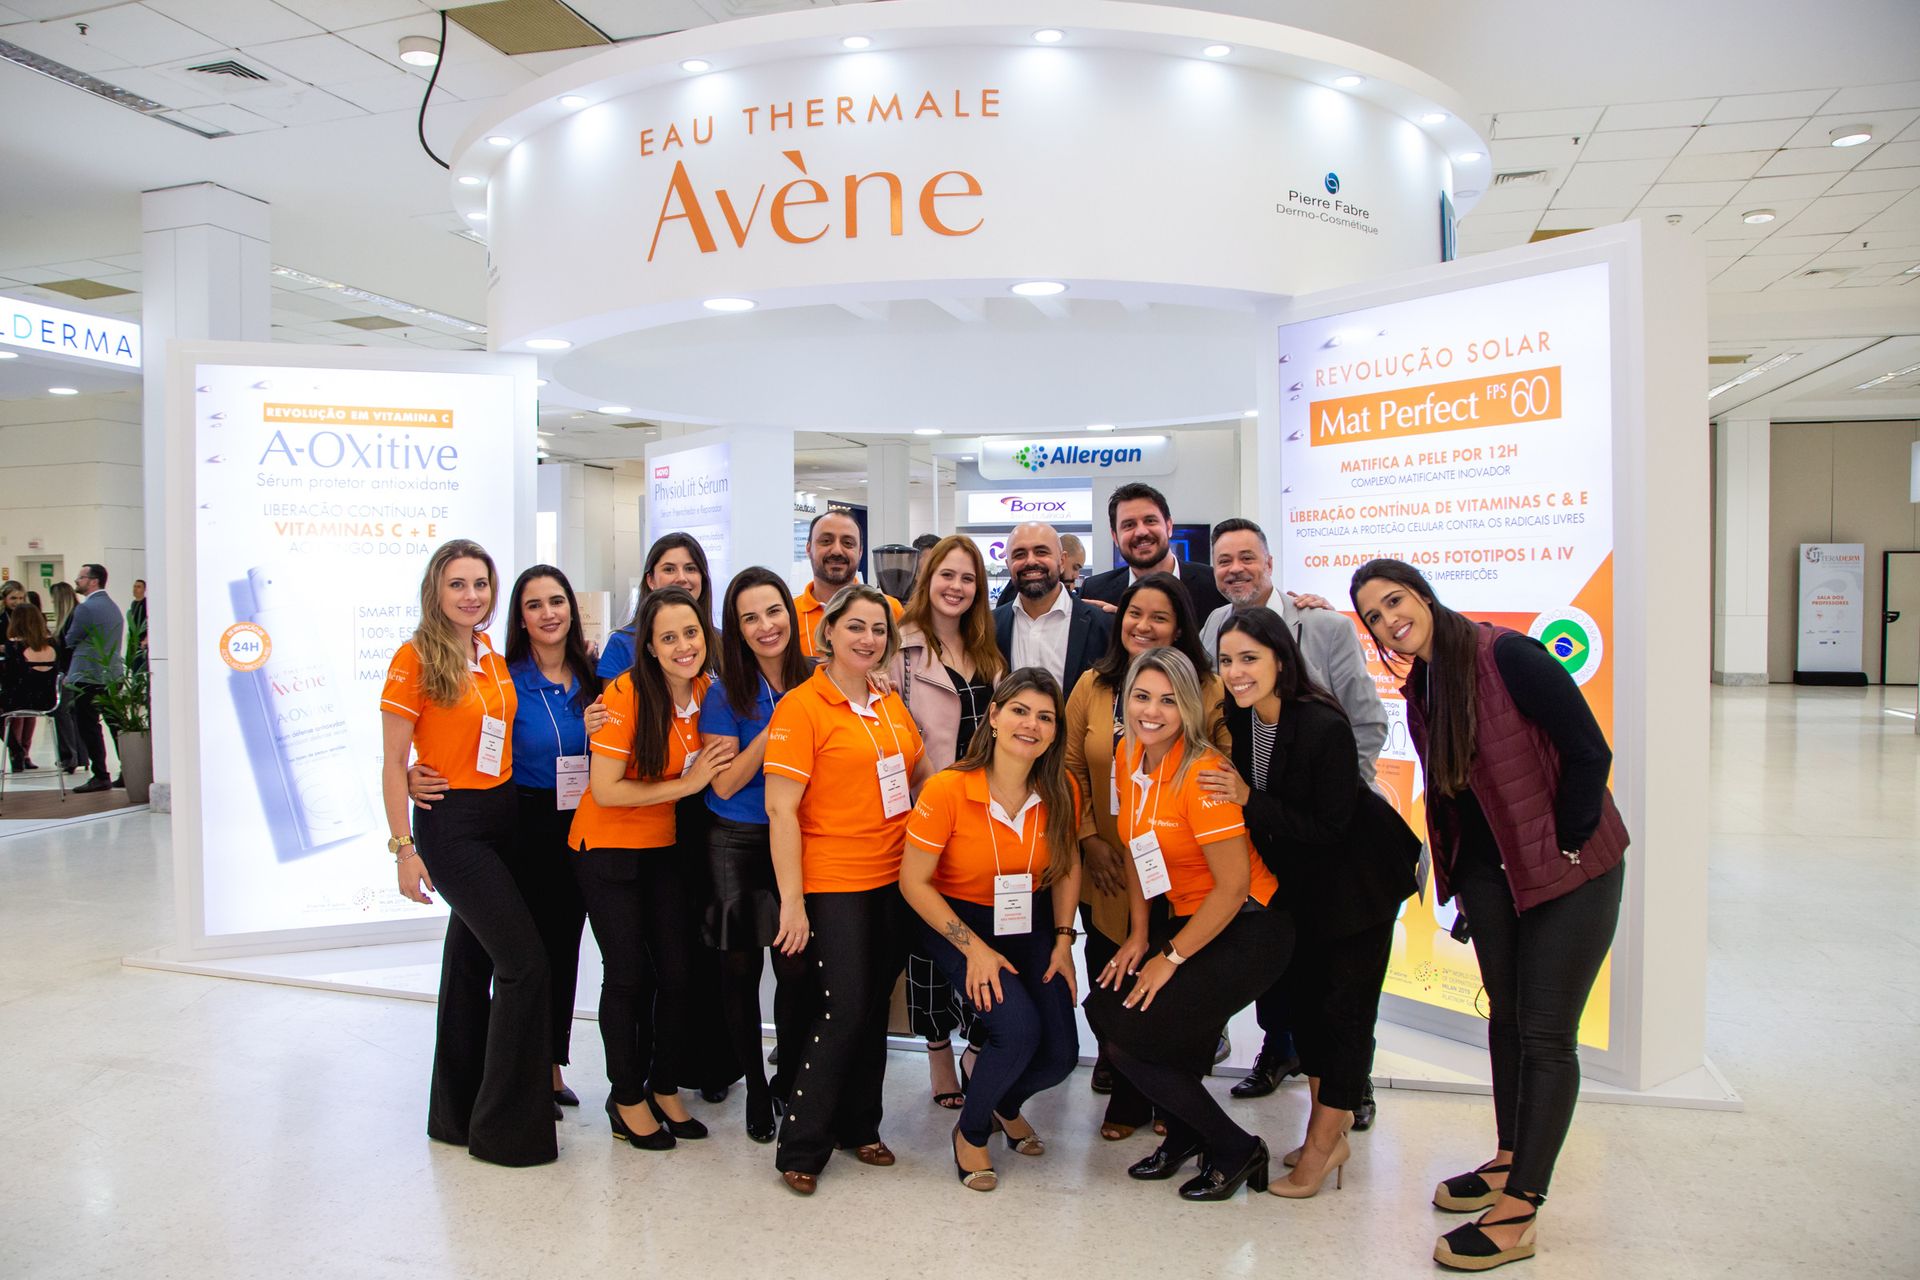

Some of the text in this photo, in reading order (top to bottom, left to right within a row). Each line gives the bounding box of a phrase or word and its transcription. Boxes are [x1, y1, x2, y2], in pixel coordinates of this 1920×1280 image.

[640, 89, 1000, 157] EAU THERMALE
[647, 149, 984, 262] Avène
[1288, 190, 1370, 219] Pierre Fabre
[1276, 203, 1379, 235] Dermo-Cosmétique
[0, 313, 132, 358] DERMA
[1315, 331, 1551, 387] REVOLUÇÃO SOLAR
[267, 407, 450, 423] REVOLUÇÃO EM VITAMINA C
[1320, 375, 1550, 437] Mat Perfect FPS 60
[258, 430, 459, 471] A-OXitive
[1051, 446, 1142, 467] Allergan
[1340, 444, 1518, 473] MATIFICA A PELE POR 12H
[257, 472, 460, 492] Sérum protetor antioxidante
[1351, 465, 1511, 488] COMPLEXO MATIFICANTE INOVADOR
[654, 474, 728, 504] PhysioLift Sérum
[263, 502, 449, 519] LIBERAÇÃO CONTÍNUA DE
[1289, 491, 1588, 523] LIBERAÇÃO CONTÍNUA DE VITAMINAS C & E
[274, 522, 386, 537] VITAMINAS
[391, 523, 403, 537] C
[427, 523, 437, 538] E
[1296, 513, 1585, 538] POTENCIALIZA A PROTEÇÃO CELULAR CONTRA OS RADICAIS LIVRES
[378, 541, 402, 555] DO
[406, 542, 429, 555] DIA
[1304, 555, 1329, 567] COR
[1411, 551, 1440, 564] AOS
[1444, 548, 1526, 564] FOTOTIPOS
[1541, 547, 1552, 561] A
[1557, 546, 1574, 560] IV
[1435, 567, 1499, 580] IMPERFEIÇÕES
[359, 606, 420, 618] SMART RE
[360, 627, 395, 640] 100%
[232, 641, 259, 652] 24H
[359, 648, 395, 660] MAIO
[360, 670, 387, 681] MAI
